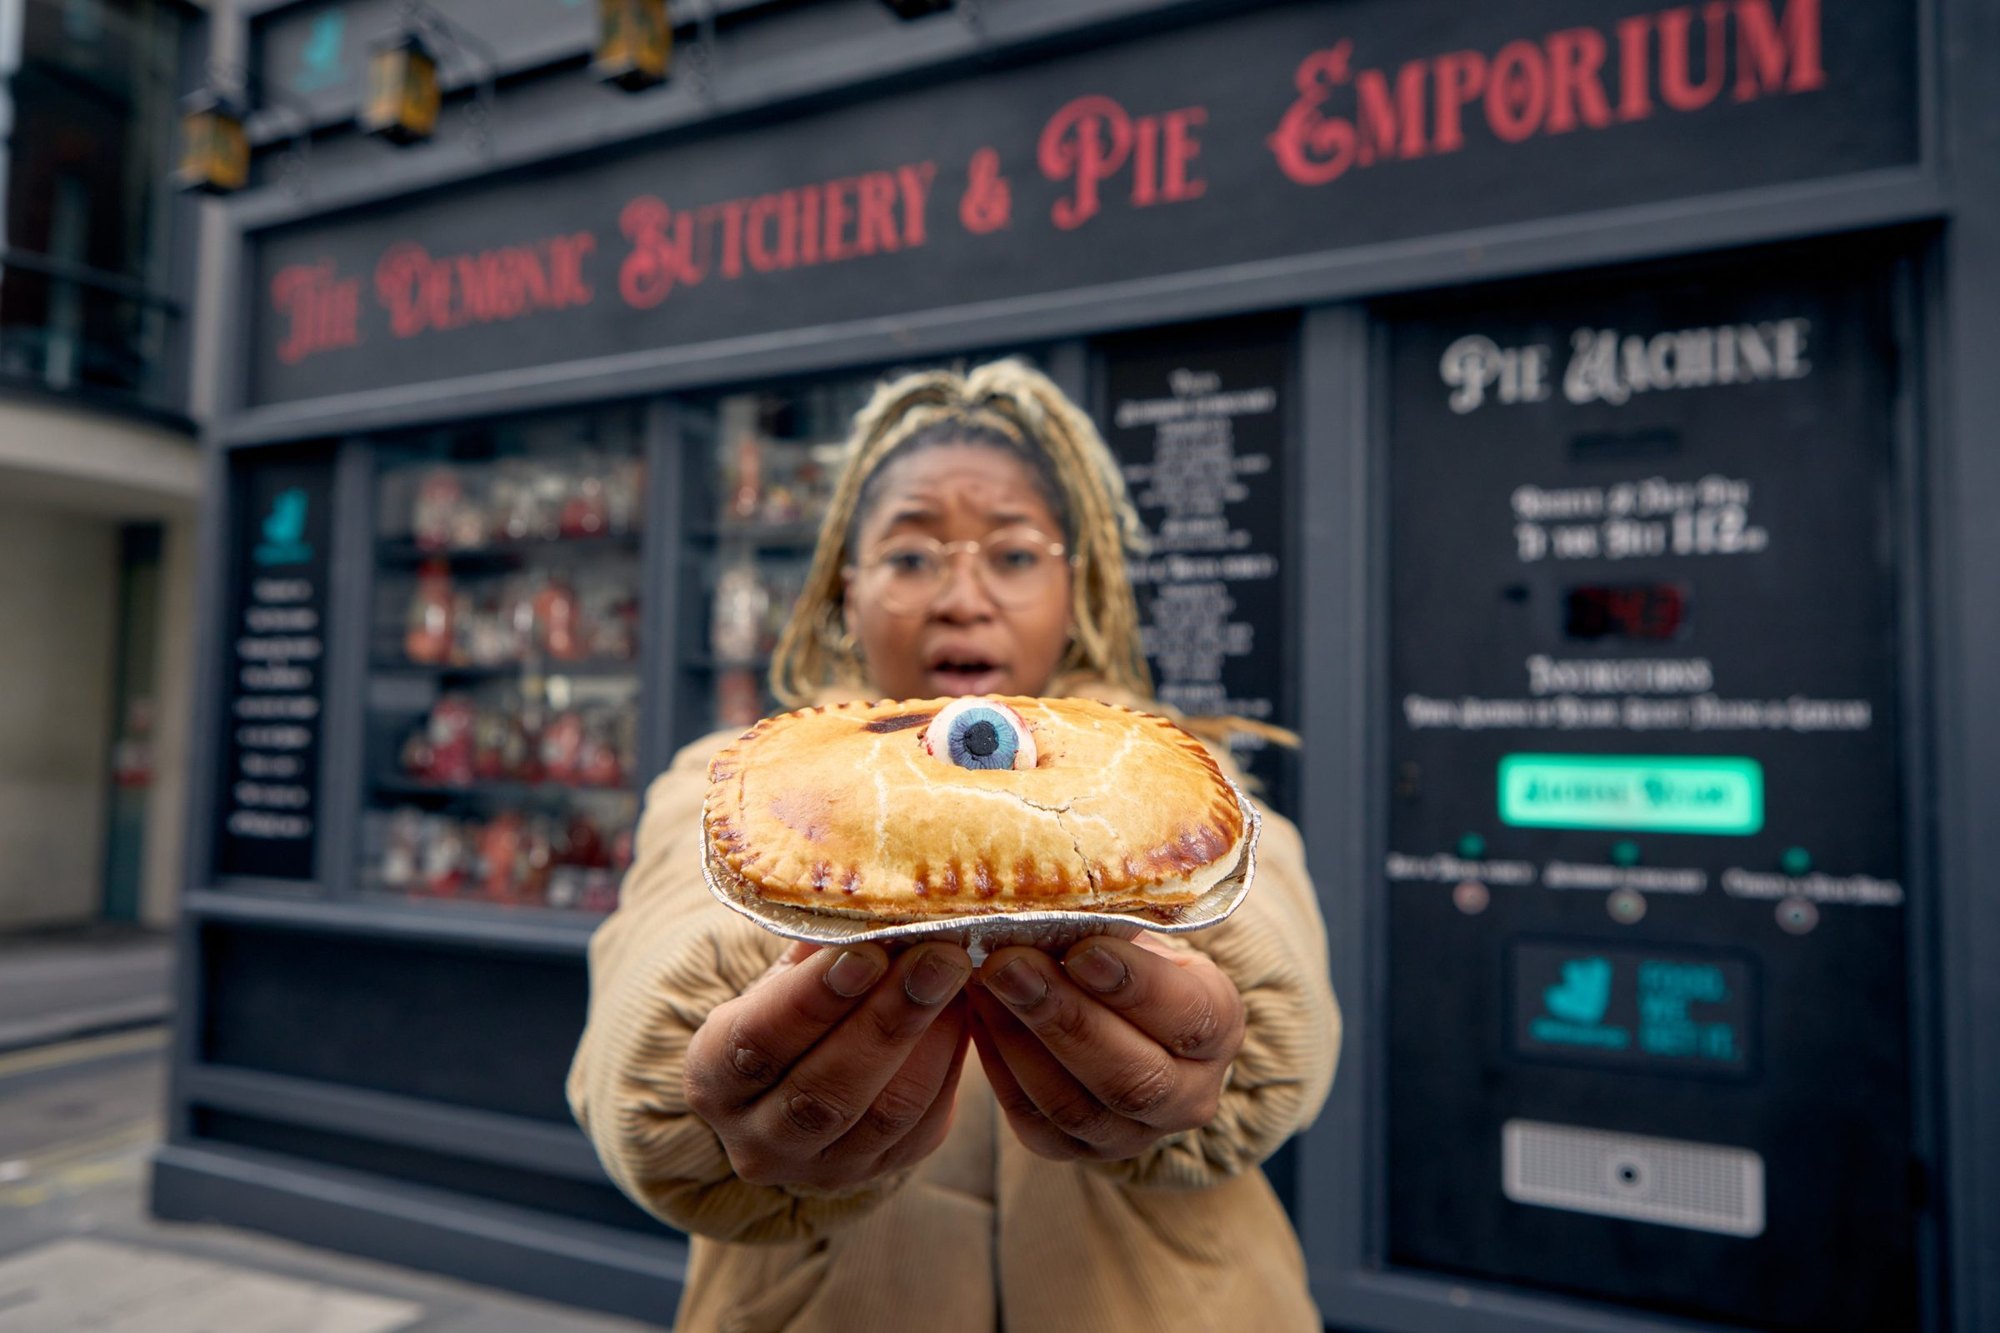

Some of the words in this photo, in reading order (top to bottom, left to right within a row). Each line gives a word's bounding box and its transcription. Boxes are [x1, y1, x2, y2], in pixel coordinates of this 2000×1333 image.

[375, 231, 597, 338] DEMONIC
[619, 161, 936, 309] BUTCHERY
[960, 147, 1011, 234] &
[1037, 95, 1208, 231] PIE
[1269, 0, 1827, 186] EMPORIUM
[1440, 334, 1551, 414] PIE
[1564, 317, 1812, 406] MACHINE
